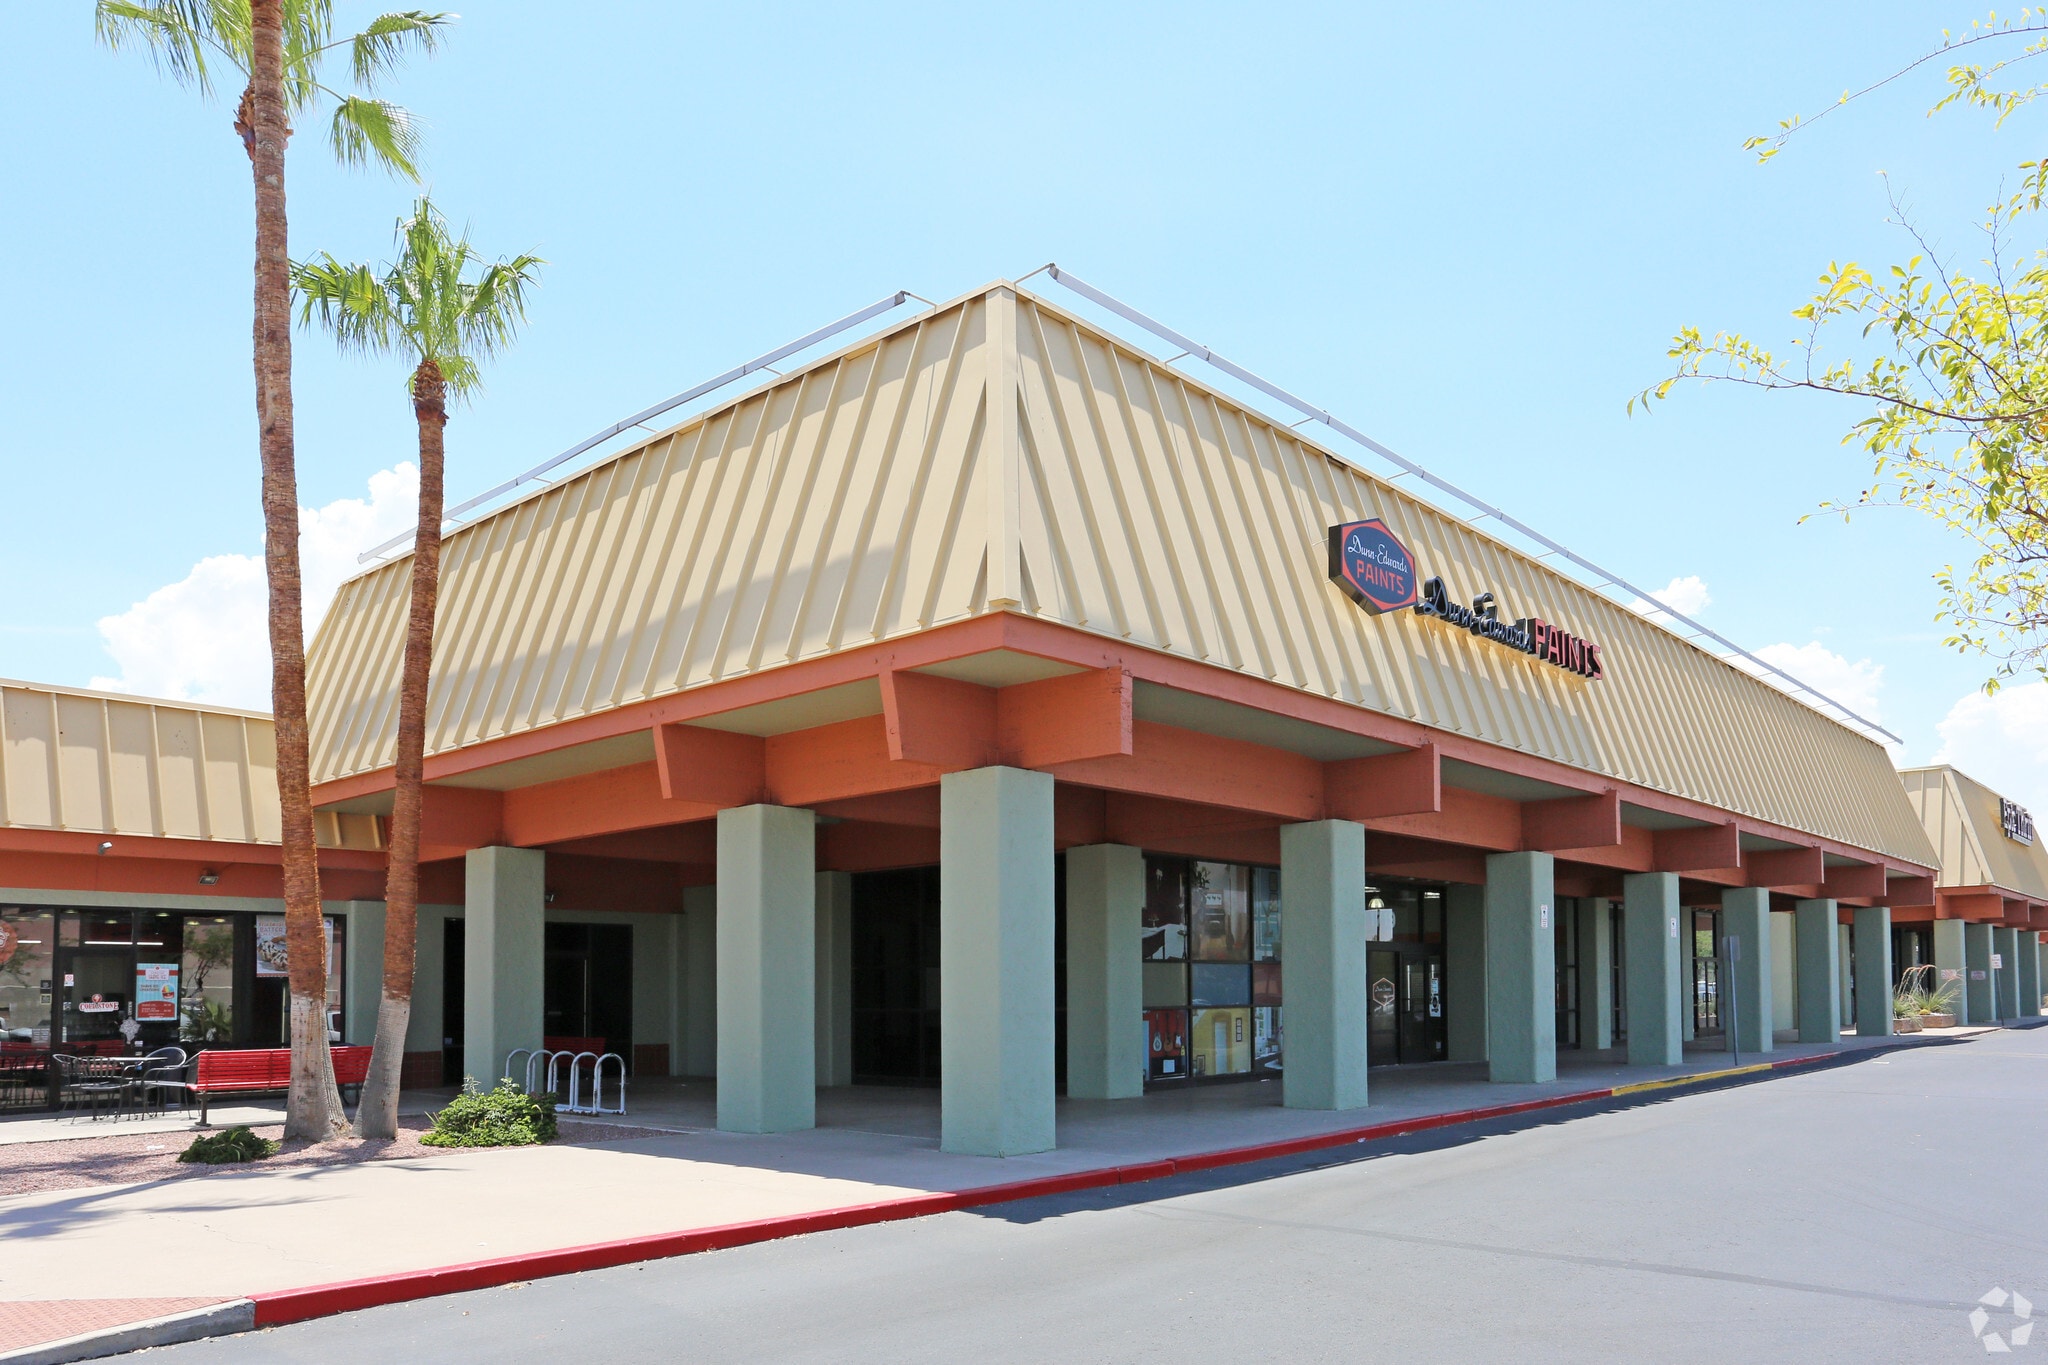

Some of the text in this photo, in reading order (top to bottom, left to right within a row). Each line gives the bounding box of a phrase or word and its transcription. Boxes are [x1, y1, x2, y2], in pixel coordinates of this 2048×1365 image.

[1347, 534, 1408, 573] Dunn-Edwards
[1356, 559, 1405, 595] PAINTS
[1528, 617, 1603, 680] PAINTS
